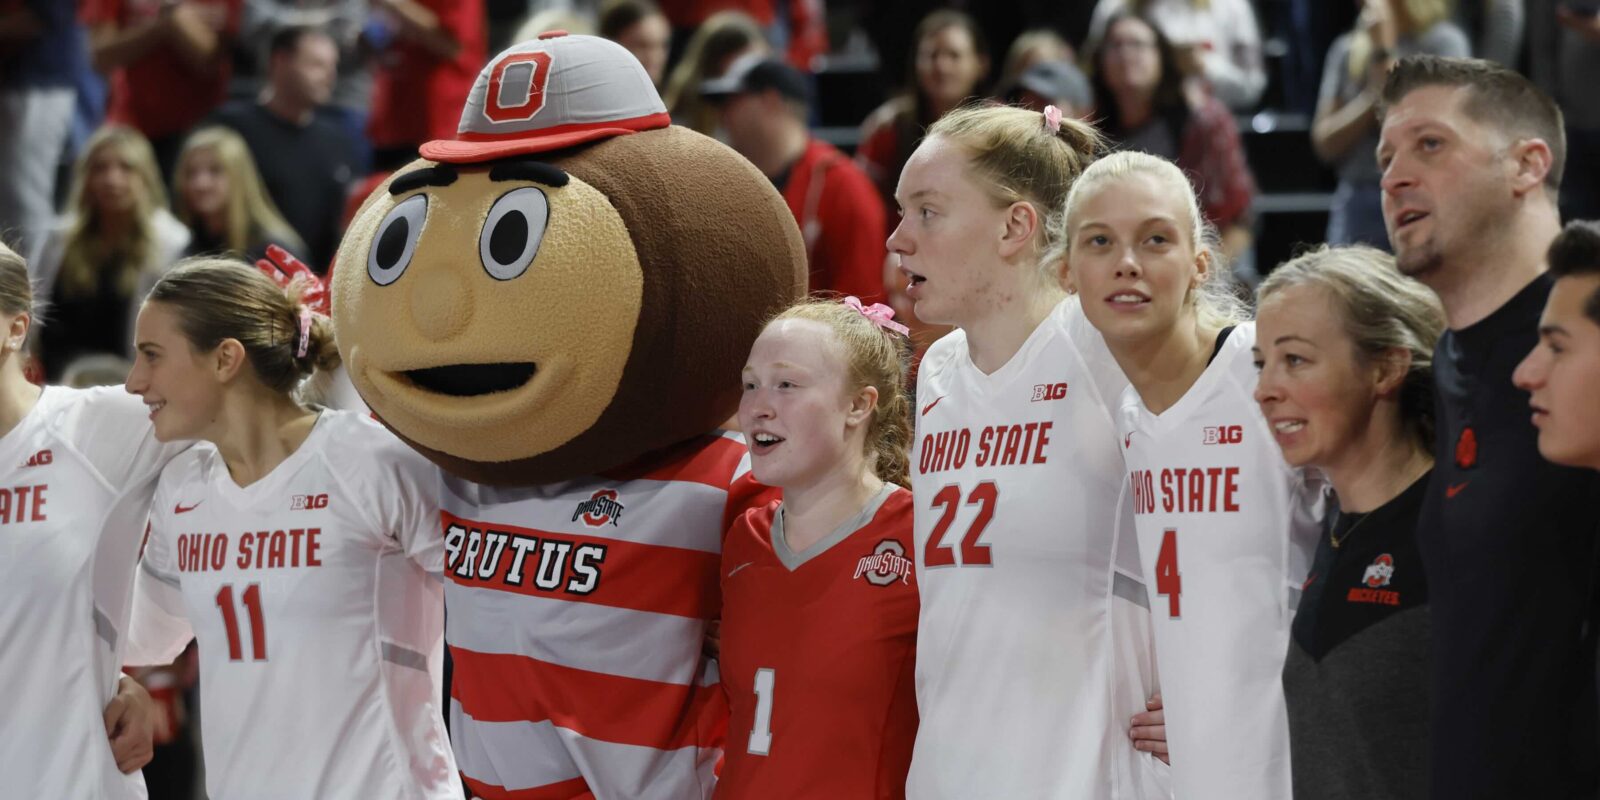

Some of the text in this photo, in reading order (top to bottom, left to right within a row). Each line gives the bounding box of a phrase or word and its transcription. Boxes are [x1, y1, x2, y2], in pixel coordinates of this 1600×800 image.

[483, 51, 554, 124] O
[919, 421, 1053, 475] OHIO STATE
[923, 479, 1000, 570] 22
[1160, 467, 1239, 513] STATE
[177, 528, 322, 572] OHIO STATE
[1155, 527, 1182, 620] 4
[215, 582, 268, 662] 11
[746, 667, 775, 756] 1
